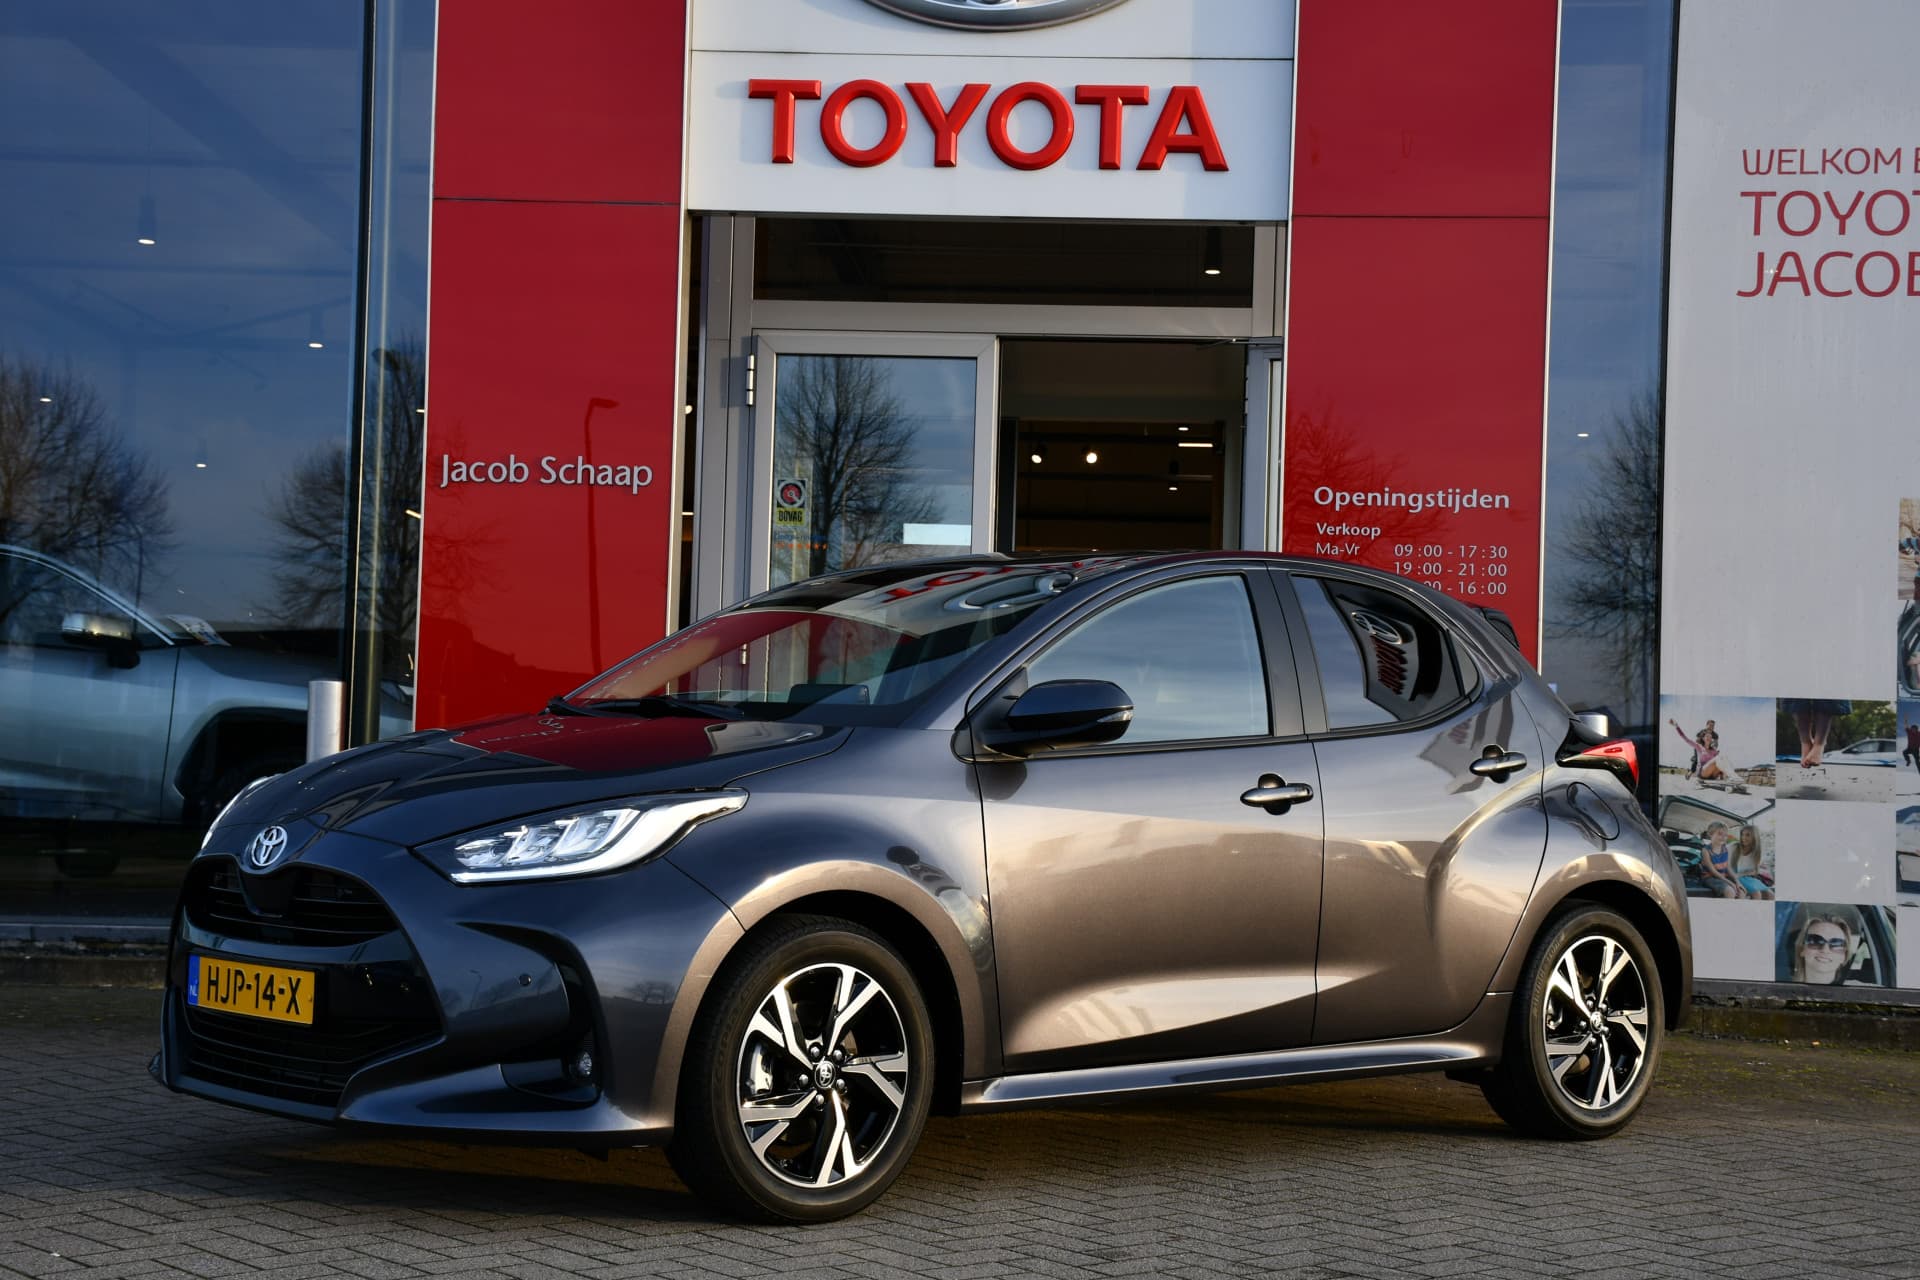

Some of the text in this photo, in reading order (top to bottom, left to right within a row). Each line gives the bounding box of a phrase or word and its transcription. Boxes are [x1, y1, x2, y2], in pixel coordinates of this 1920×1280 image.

[748, 78, 1229, 171] TOYOTA
[1742, 147, 1902, 176] WELKOM
[1740, 189, 1920, 237] TOYO
[440, 454, 653, 495] Jacob Schaap
[1313, 486, 1510, 513] Openingstijden
[1316, 522, 1381, 540] Verkoop
[1316, 542, 1361, 556] Ma-Vr
[207, 964, 302, 1016] HJP-14-X
